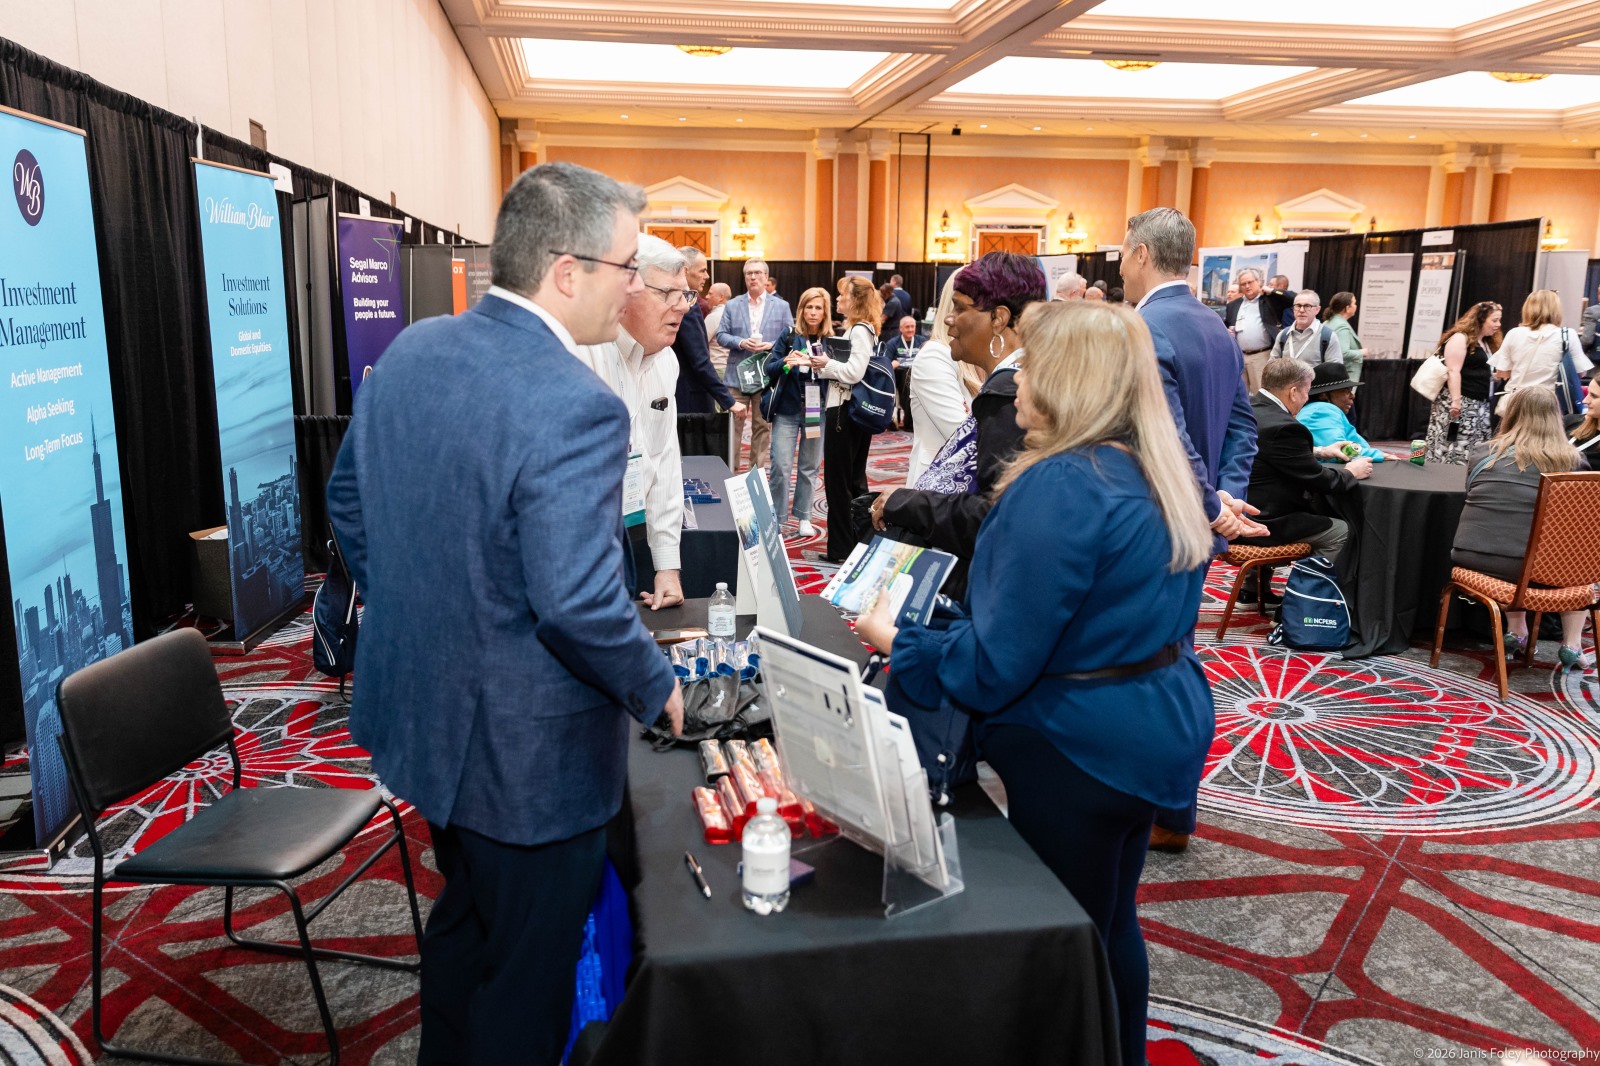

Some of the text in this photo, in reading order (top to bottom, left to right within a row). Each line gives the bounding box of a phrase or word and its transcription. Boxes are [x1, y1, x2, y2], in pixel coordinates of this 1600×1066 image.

[205, 197, 274, 230] William Blair
[350, 257, 388, 271] Segal Marco
[222, 273, 270, 292] Investment
[352, 271, 378, 284] Advisors
[1, 278, 77, 307] Investment
[229, 298, 267, 316] Solutions
[353, 297, 389, 309] Building your
[354, 309, 397, 321] people a future.
[0, 317, 87, 349] Management
[238, 329, 261, 341] Global and
[230, 342, 272, 357] Domestic Equities
[11, 363, 83, 388] Active Management
[27, 398, 75, 425] Alpha Seeking
[25, 432, 83, 461] Long-Term Focus
[1313, 617, 1337, 625] NCPERS
